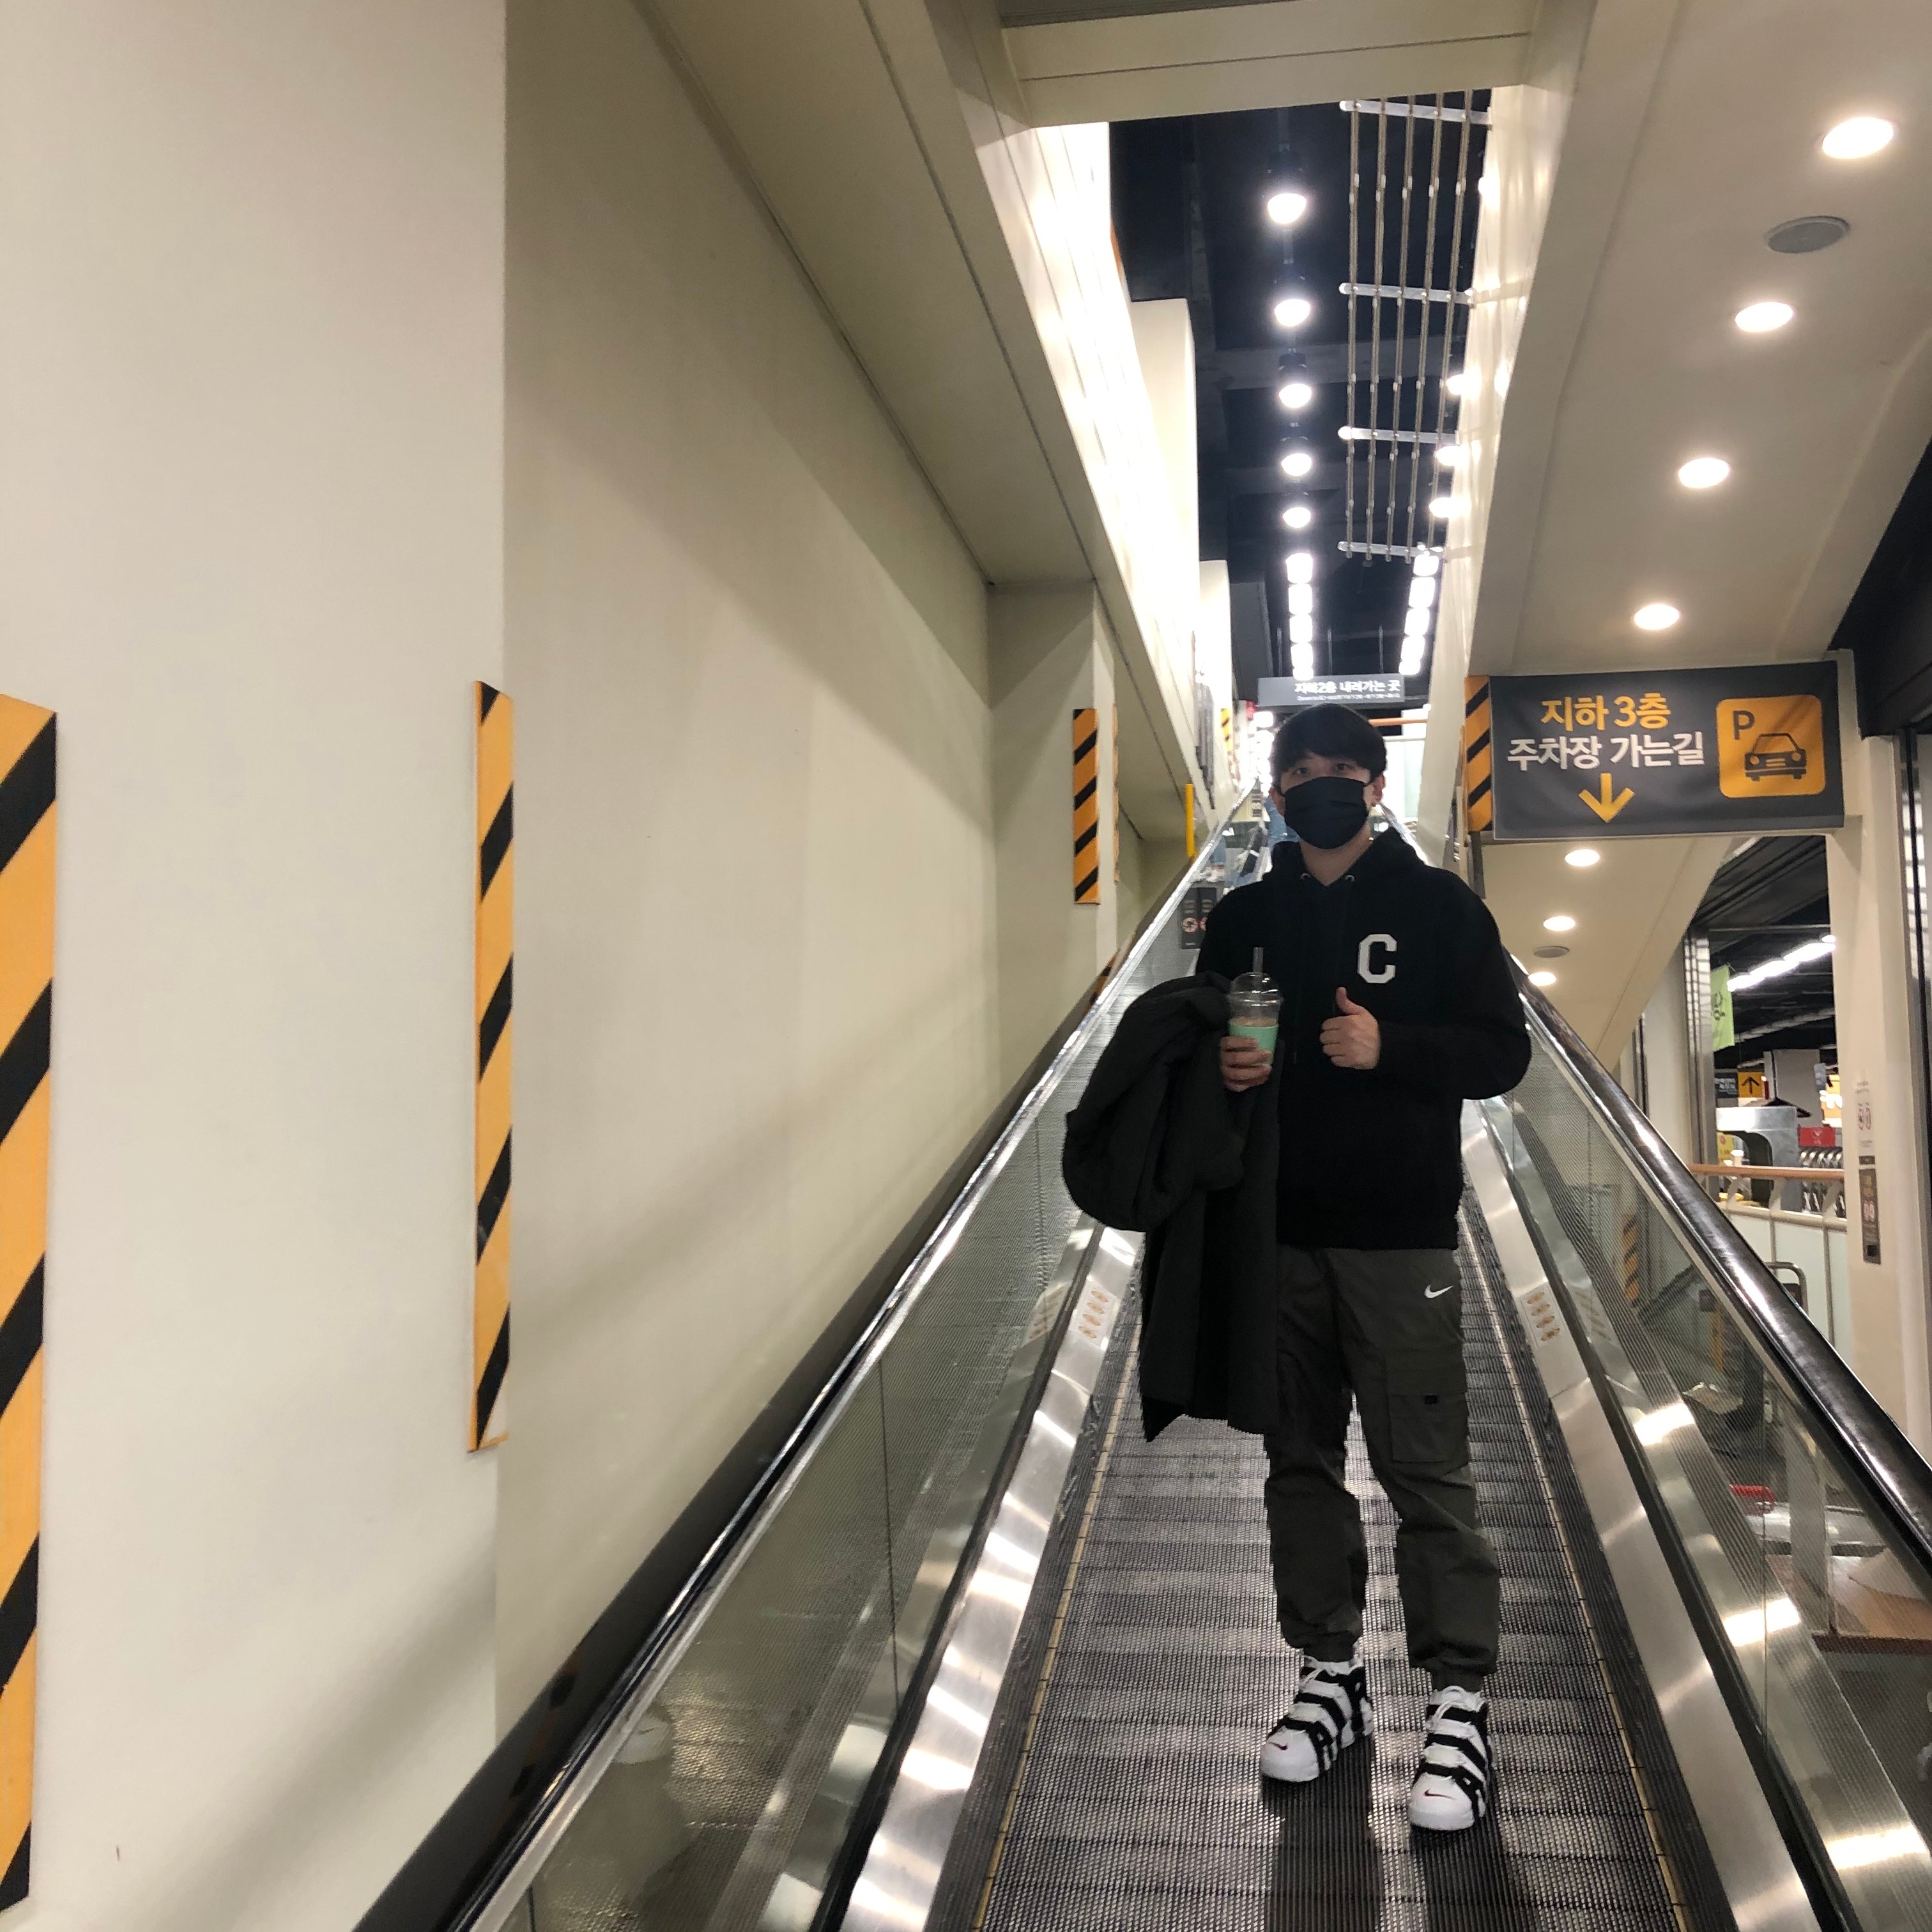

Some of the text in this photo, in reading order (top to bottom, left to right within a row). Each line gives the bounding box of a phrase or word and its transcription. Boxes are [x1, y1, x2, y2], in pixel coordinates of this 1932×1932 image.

[1540, 692, 1671, 732] 지하 3층
[1733, 710, 1756, 741] P
[1507, 730, 1705, 771] 주차장 가는길
[1357, 933, 1398, 984] C
